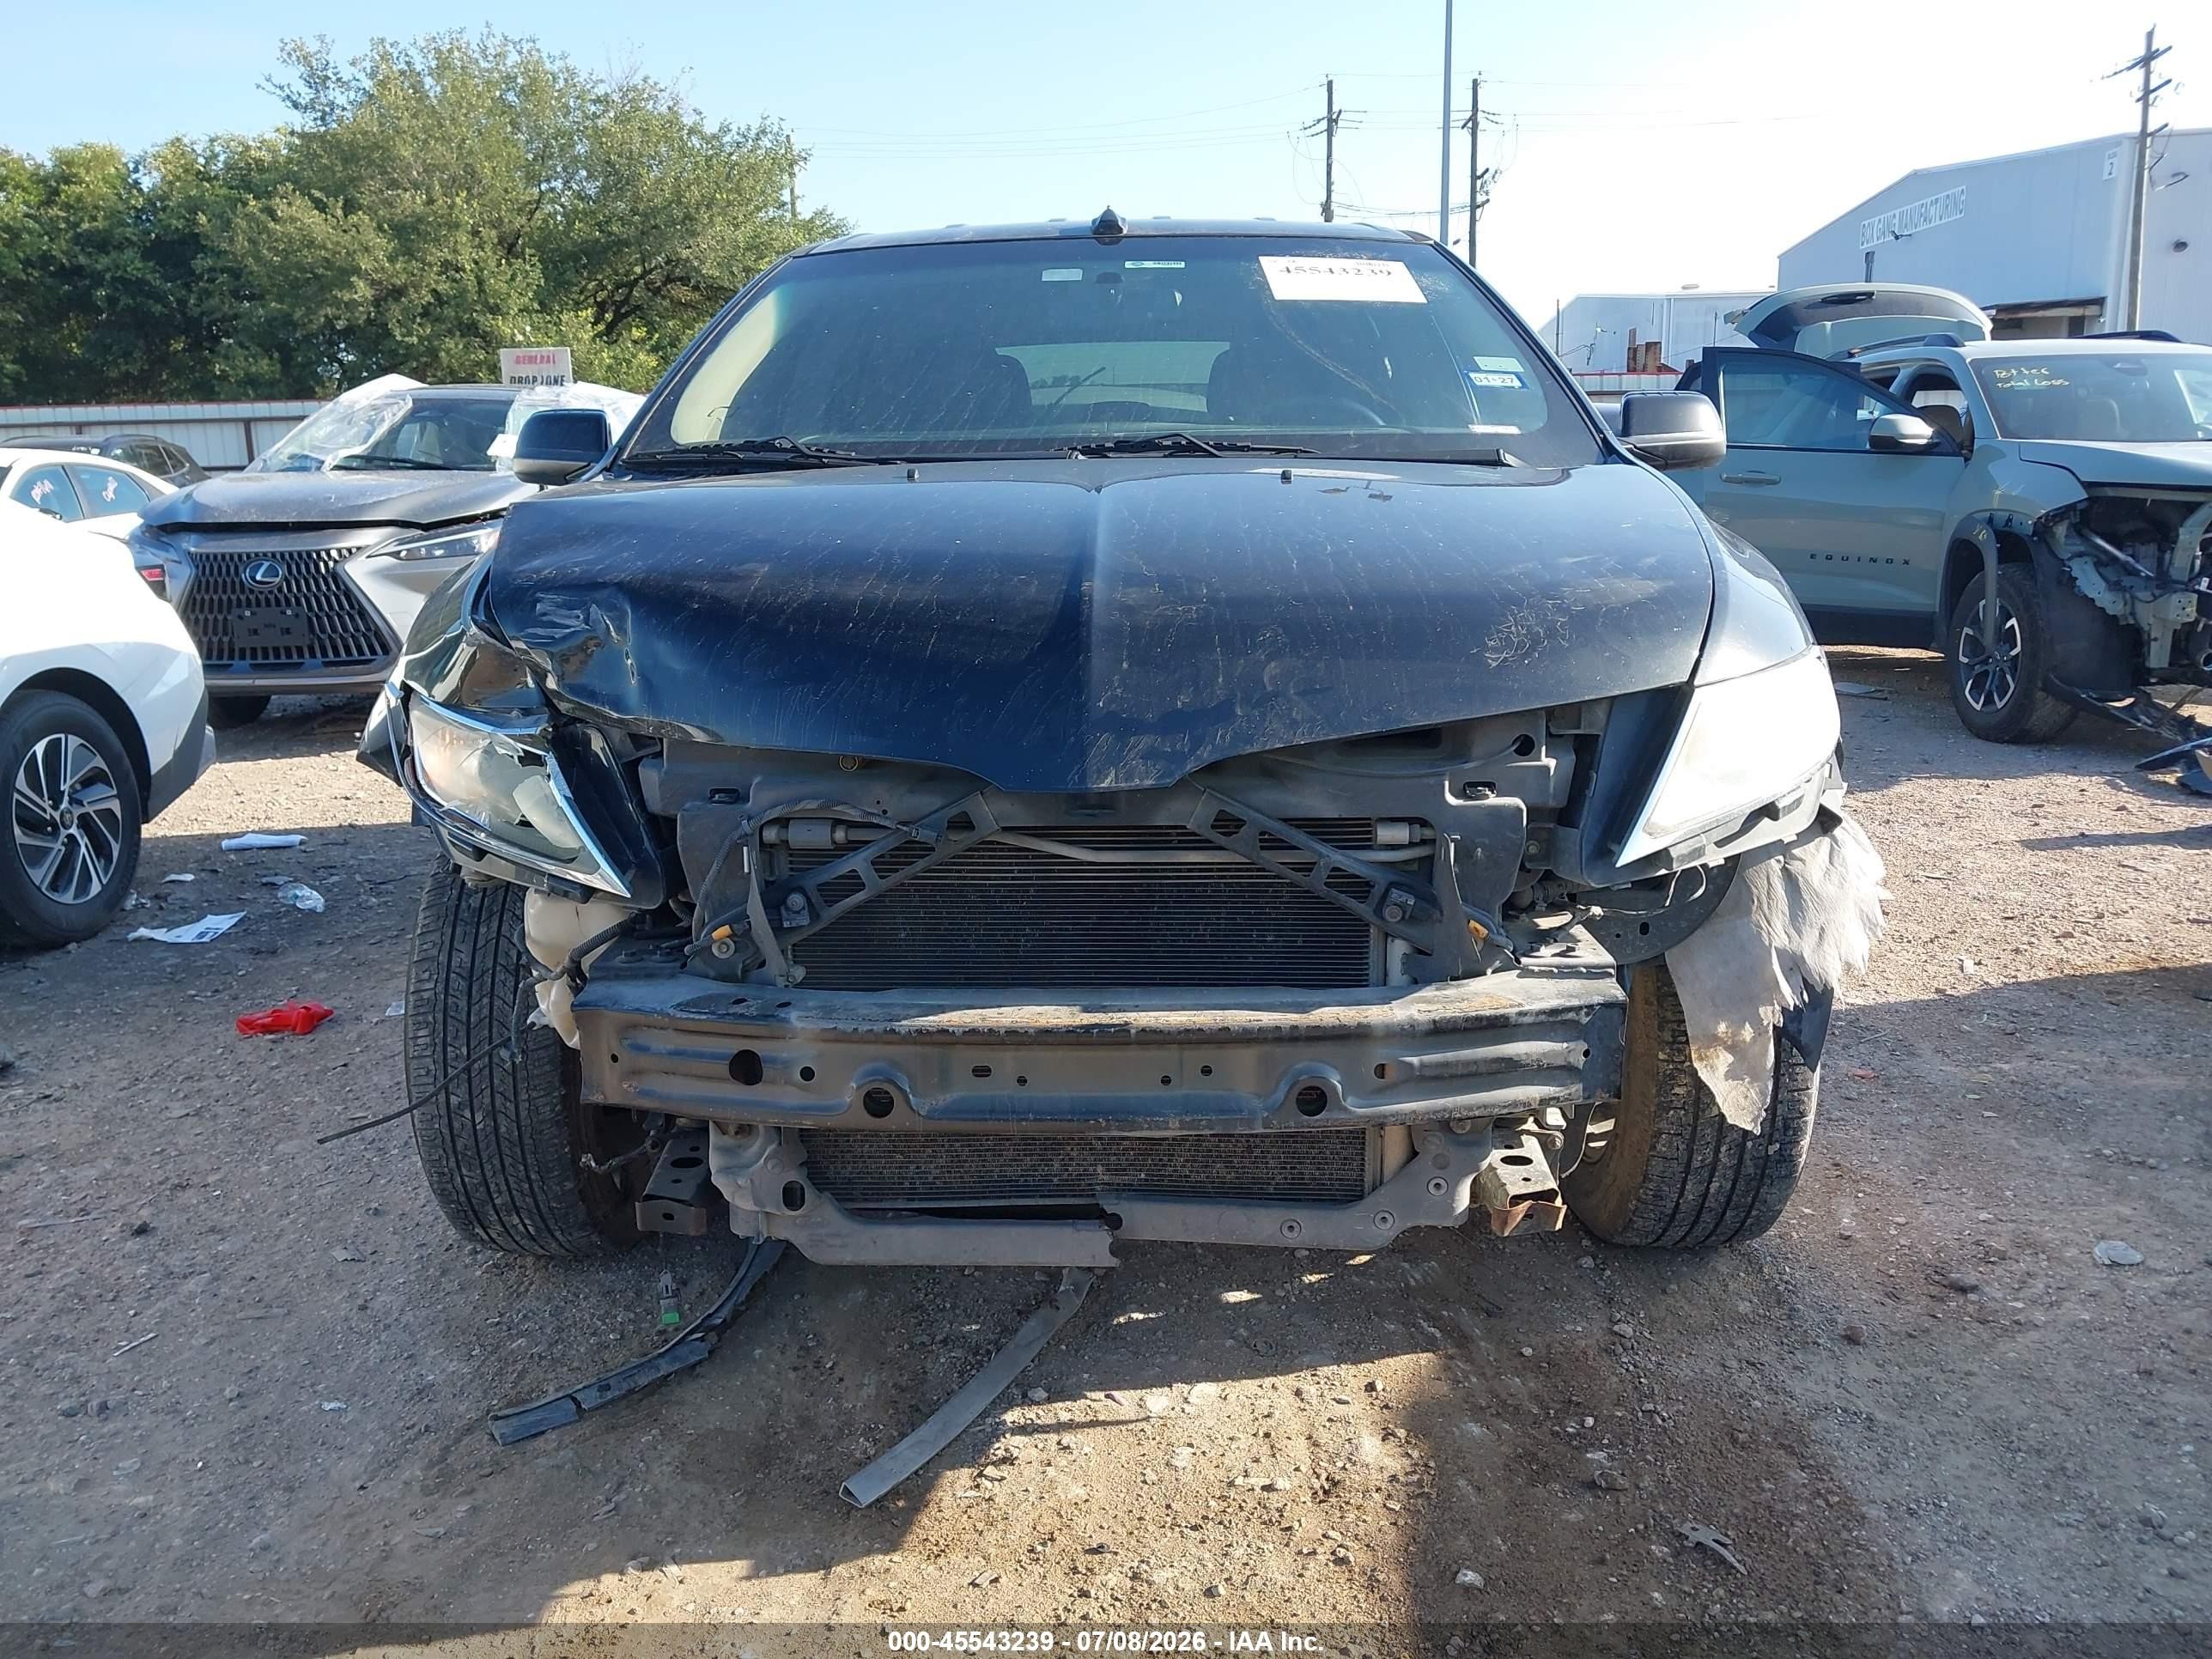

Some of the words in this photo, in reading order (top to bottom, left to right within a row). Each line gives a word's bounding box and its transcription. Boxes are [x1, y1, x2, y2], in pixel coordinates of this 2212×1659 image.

[1861, 219, 1875, 247] BOX
[1897, 187, 1965, 234] MANUFACTURING
[1279, 266, 1392, 276] 45543239
[515, 353, 556, 365] GENERAL
[509, 374, 538, 385] DROP
[1809, 553, 1911, 566] EQUINOX
